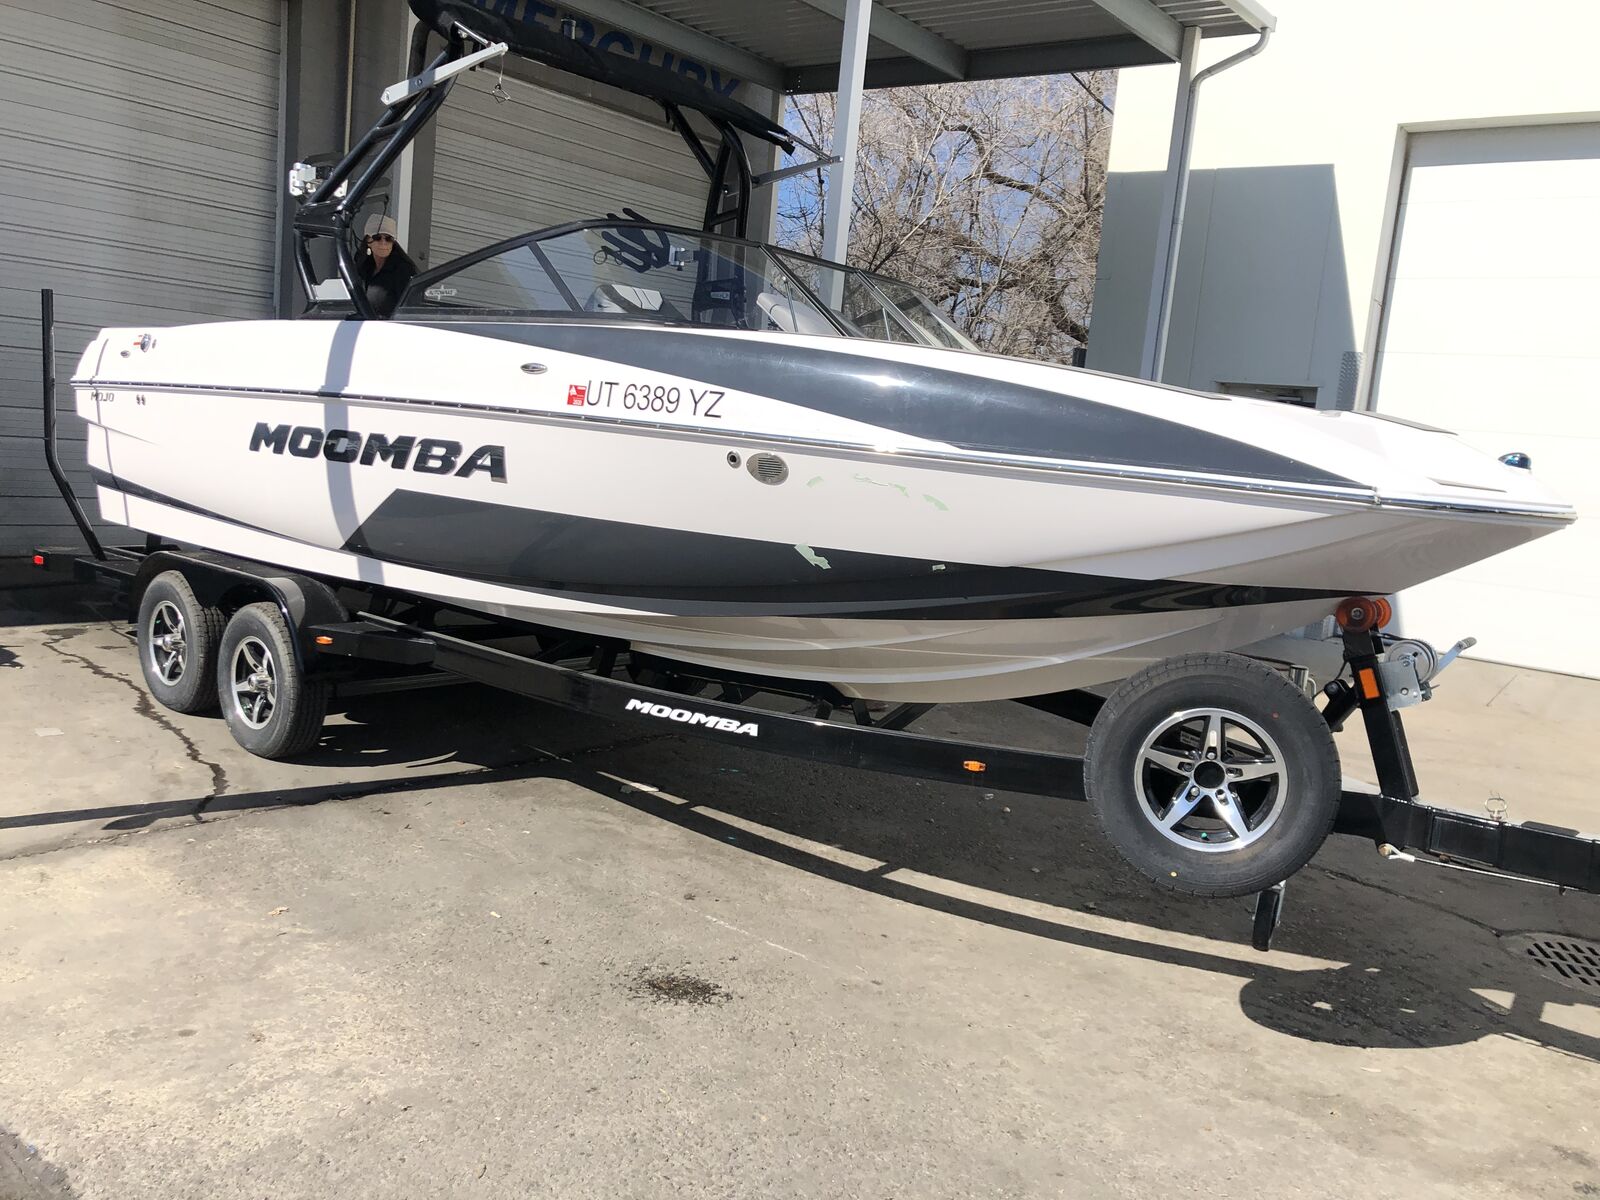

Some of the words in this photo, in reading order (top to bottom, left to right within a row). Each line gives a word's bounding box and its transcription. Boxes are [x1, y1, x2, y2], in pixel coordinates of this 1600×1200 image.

[91, 392, 115, 402] MOJO
[587, 380, 619, 407] UT
[624, 384, 680, 413] 6389
[690, 389, 725, 418] YZ
[249, 422, 508, 484] MOOMBA
[625, 698, 759, 737] MOOMBA
